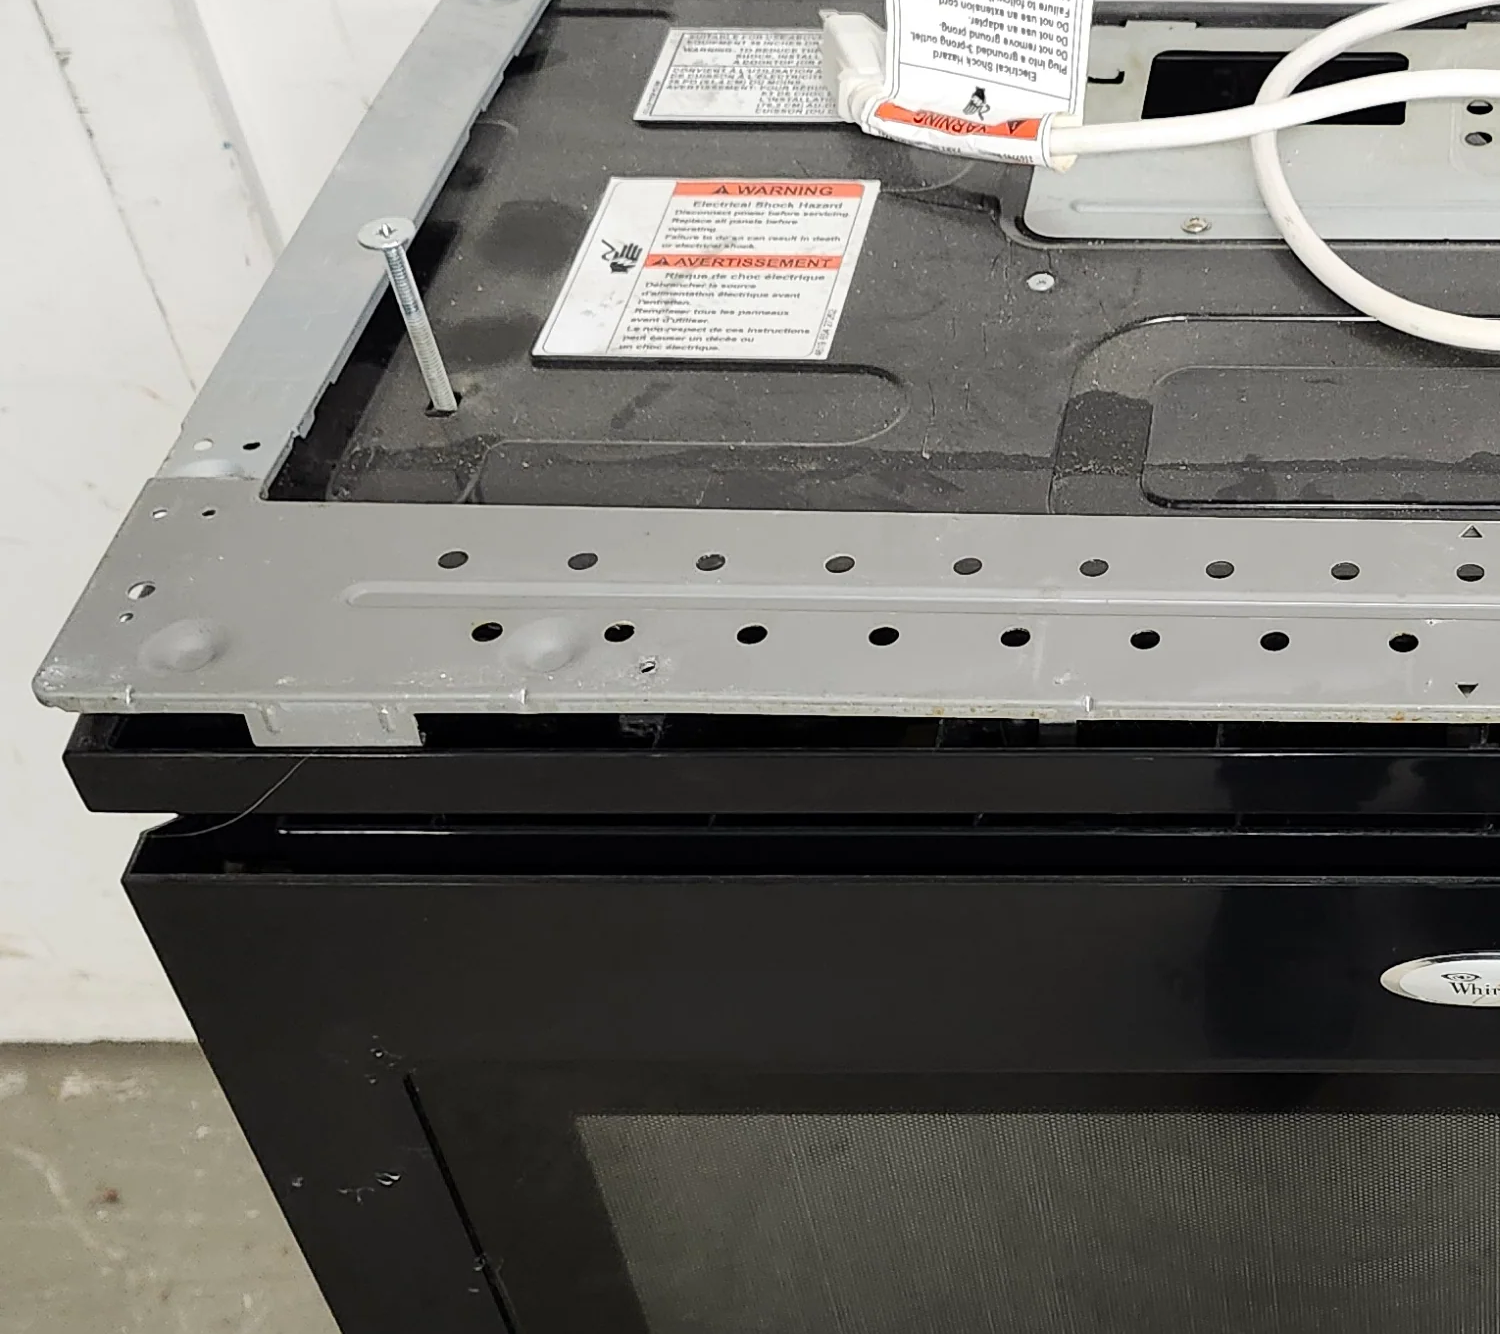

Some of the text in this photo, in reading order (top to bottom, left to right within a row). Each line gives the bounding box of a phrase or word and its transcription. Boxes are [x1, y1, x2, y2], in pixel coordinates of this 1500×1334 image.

[960, 1, 1004, 16] extension
[1027, 0, 1036, 11] to
[1038, 2, 1070, 19] Failure
[1006, 10, 1018, 19] an
[1021, 13, 1037, 23] use
[1040, 17, 1054, 27] not
[1056, 21, 1069, 33] Do
[968, 16, 1068, 47] Do not use an adapter.
[939, 21, 1068, 61] Do not remove ground prong.
[940, 35, 973, 54] 3-prong
[976, 45, 1018, 62] grounded
[1020, 55, 1026, 64] a
[933, 50, 1037, 82] Electrical Shock Hazard
[1028, 57, 1046, 70] into
[1047, 58, 1067, 75] Plug
[737, 185, 834, 195] WARNING
[693, 200, 843, 209] Electrical Shock Hazard
[673, 257, 833, 268] AVERTISSEMENT
[665, 272, 708, 280] Risque
[764, 273, 825, 282] électrique
